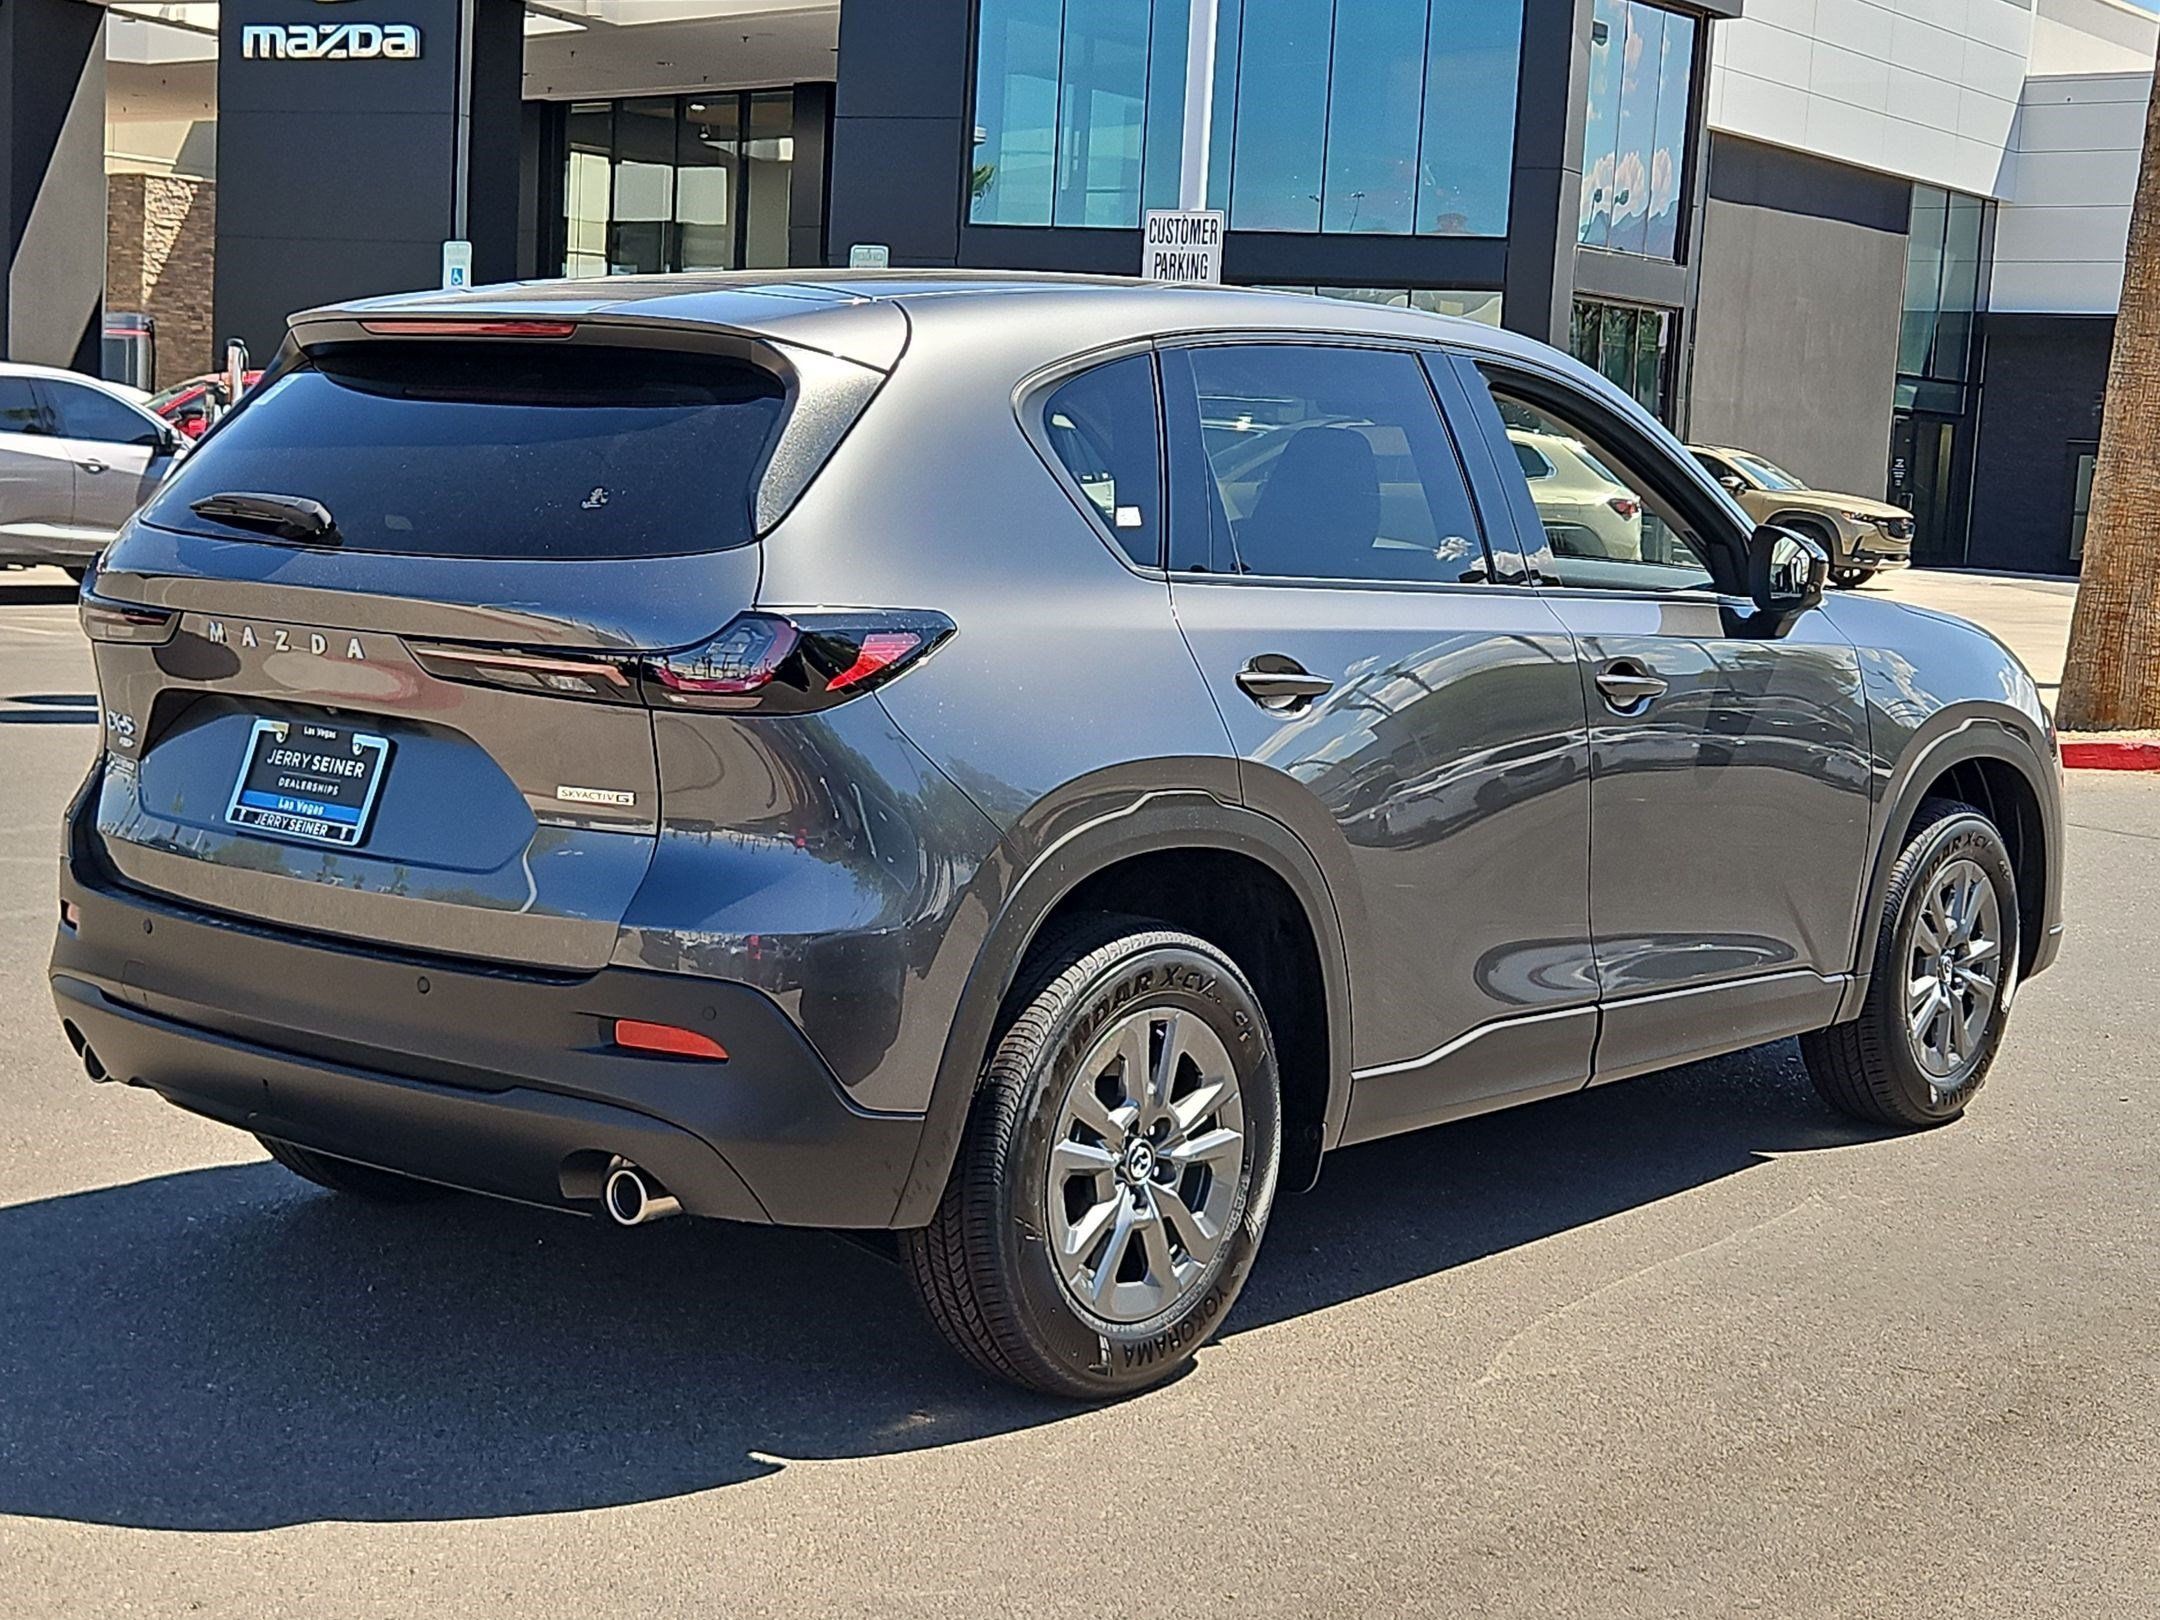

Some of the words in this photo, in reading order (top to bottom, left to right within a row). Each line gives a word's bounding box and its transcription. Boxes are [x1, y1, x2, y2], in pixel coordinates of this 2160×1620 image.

[1149, 217, 1218, 245] CUSTOMER
[1153, 252, 1208, 280] PARKING
[209, 620, 365, 660] MAZDA
[304, 726, 315, 735] Las
[317, 728, 337, 739] Vegas
[267, 749, 311, 768] JERRY
[312, 755, 365, 778] SEINER
[278, 777, 339, 796] DEALERSHIPS
[278, 797, 295, 811] Las
[297, 801, 325, 816] Vegas
[254, 813, 289, 829] JERRY
[288, 819, 329, 837] SEINER
[1122, 1285, 1228, 1368] YOKOHAMA
